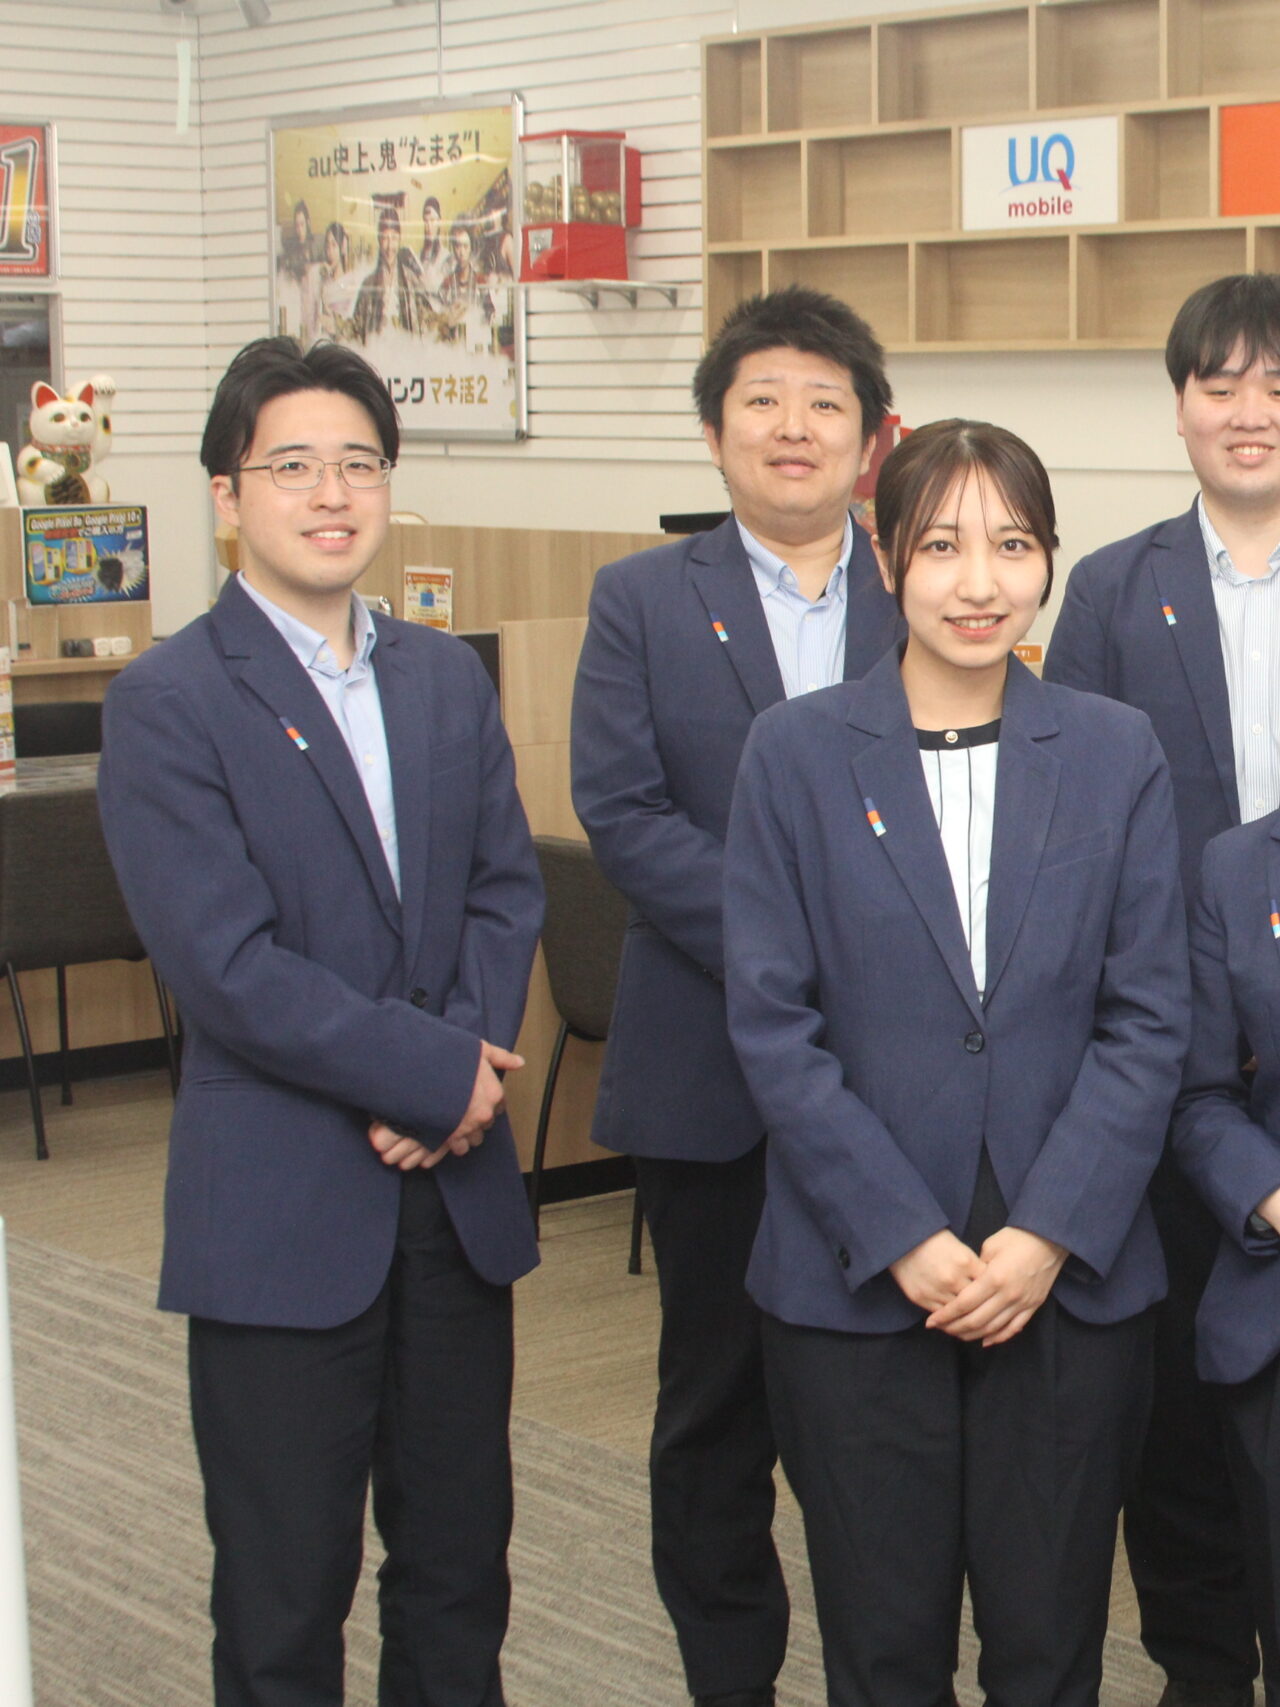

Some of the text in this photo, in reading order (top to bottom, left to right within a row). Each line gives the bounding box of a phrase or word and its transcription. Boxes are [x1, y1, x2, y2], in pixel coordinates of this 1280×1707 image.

[1008, 133, 1075, 191] UQ
[1008, 197, 1073, 217] mobile
[430, 374, 488, 405] マネ活2
